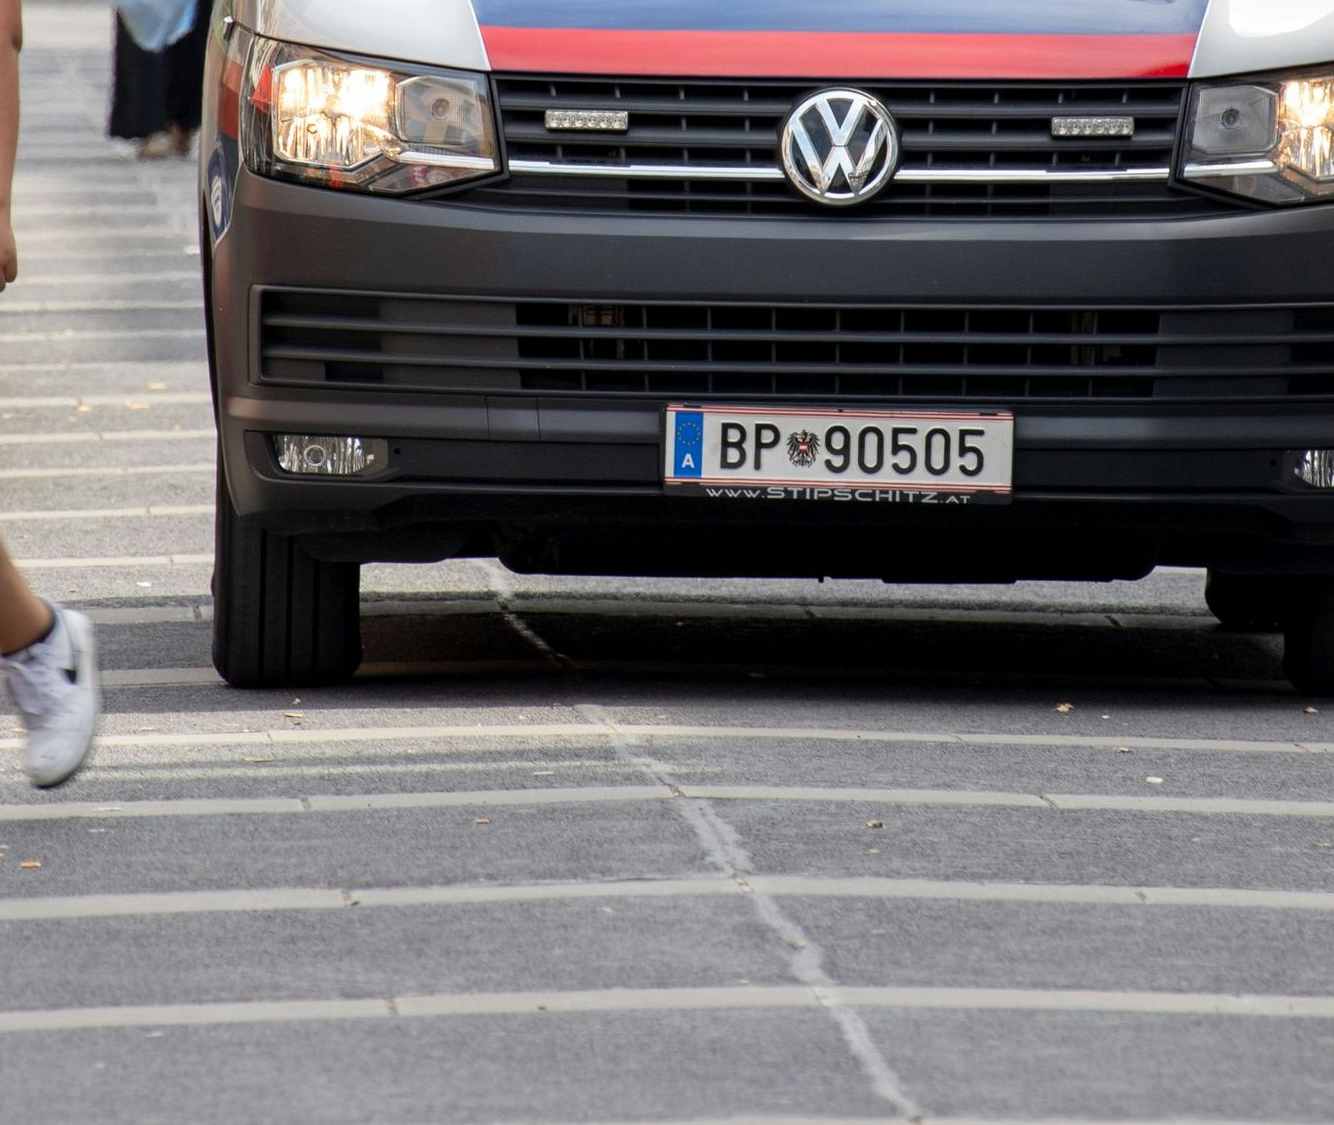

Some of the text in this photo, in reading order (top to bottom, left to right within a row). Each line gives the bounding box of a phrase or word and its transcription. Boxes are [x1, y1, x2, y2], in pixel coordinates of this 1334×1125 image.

[681, 453, 695, 469] A
[720, 422, 986, 476] BP 90505
